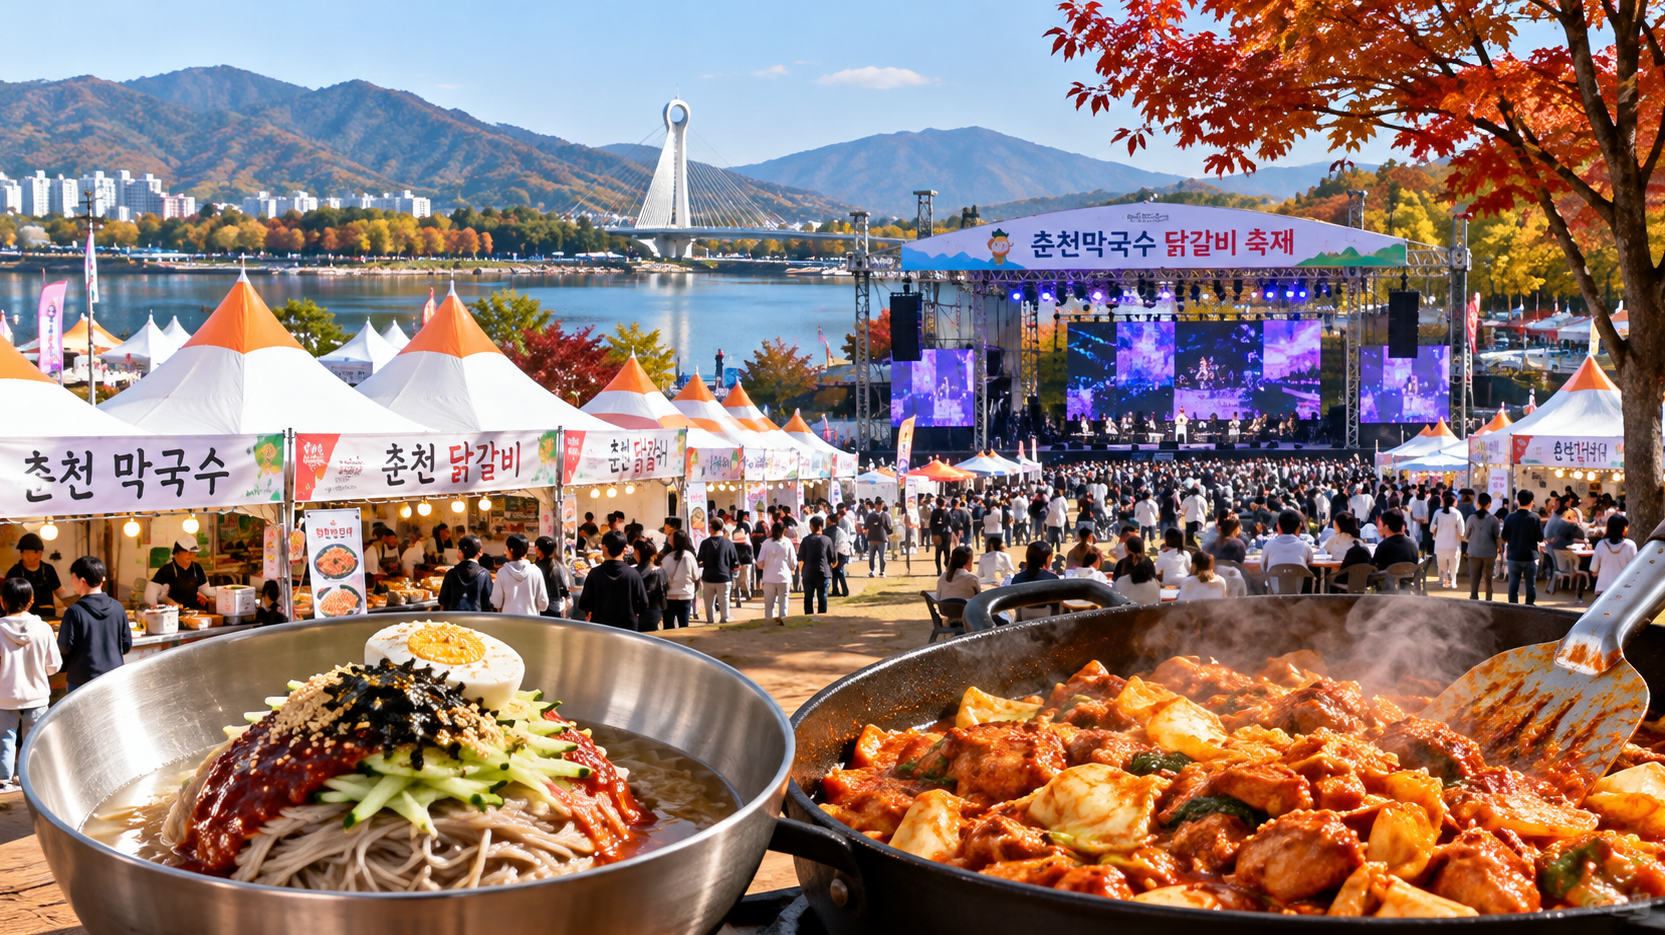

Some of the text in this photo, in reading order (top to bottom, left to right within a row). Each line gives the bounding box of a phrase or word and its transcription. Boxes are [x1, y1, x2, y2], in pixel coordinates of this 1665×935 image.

[1031, 228, 1294, 258] 춘천막국수 닭갈비 축제
[24, 447, 230, 502] 춘천 막국수
[381, 442, 436, 486] 춘천
[449, 441, 521, 483] 닭갈비
